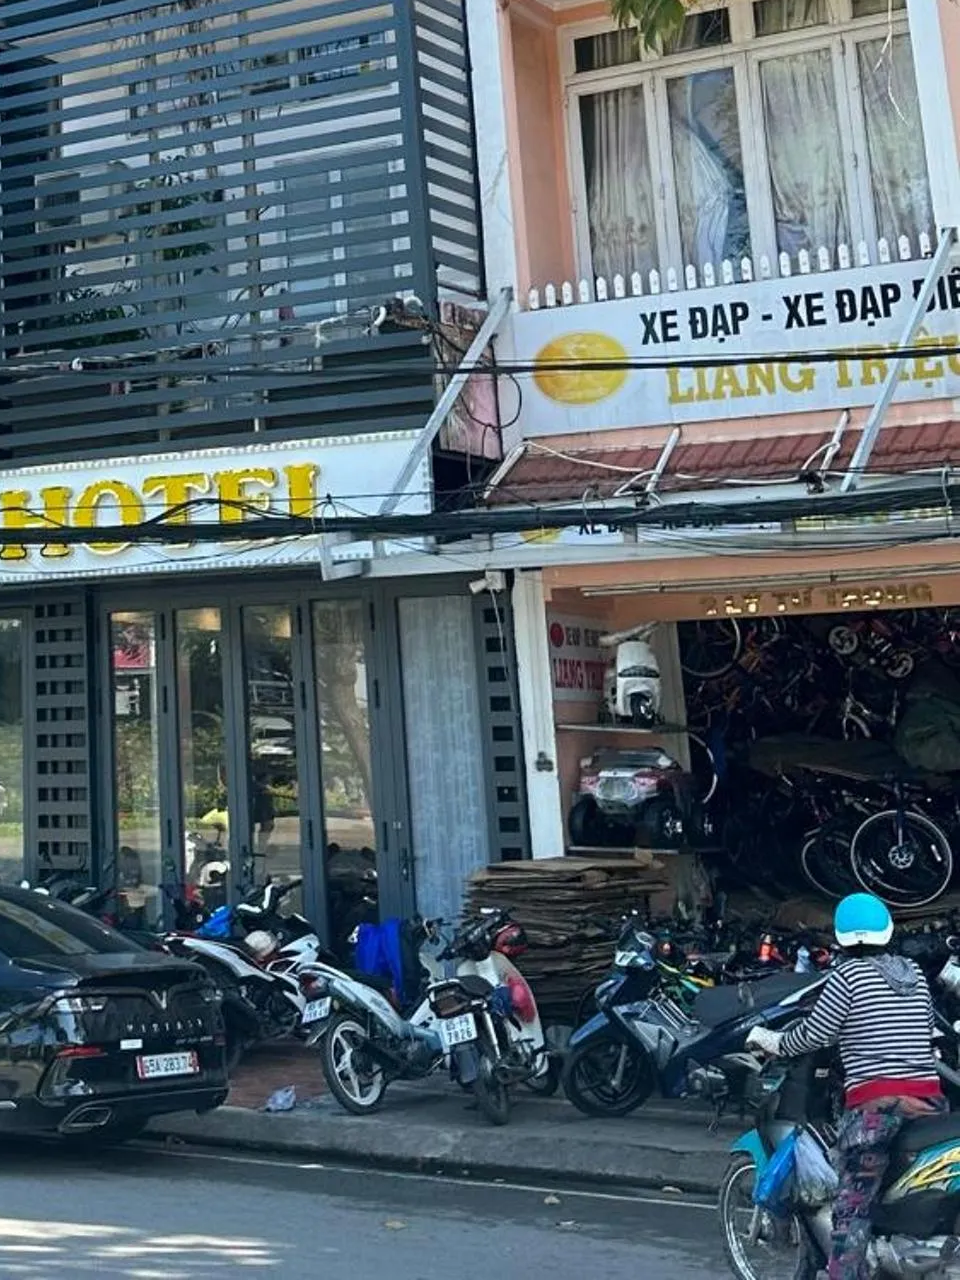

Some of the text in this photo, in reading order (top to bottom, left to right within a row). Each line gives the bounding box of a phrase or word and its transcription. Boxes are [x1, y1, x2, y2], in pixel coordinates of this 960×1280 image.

[640, 310, 681, 346] XE
[688, 301, 750, 343] ĐẠP
[782, 292, 827, 329] XE
[834, 283, 901, 327] ĐẠP
